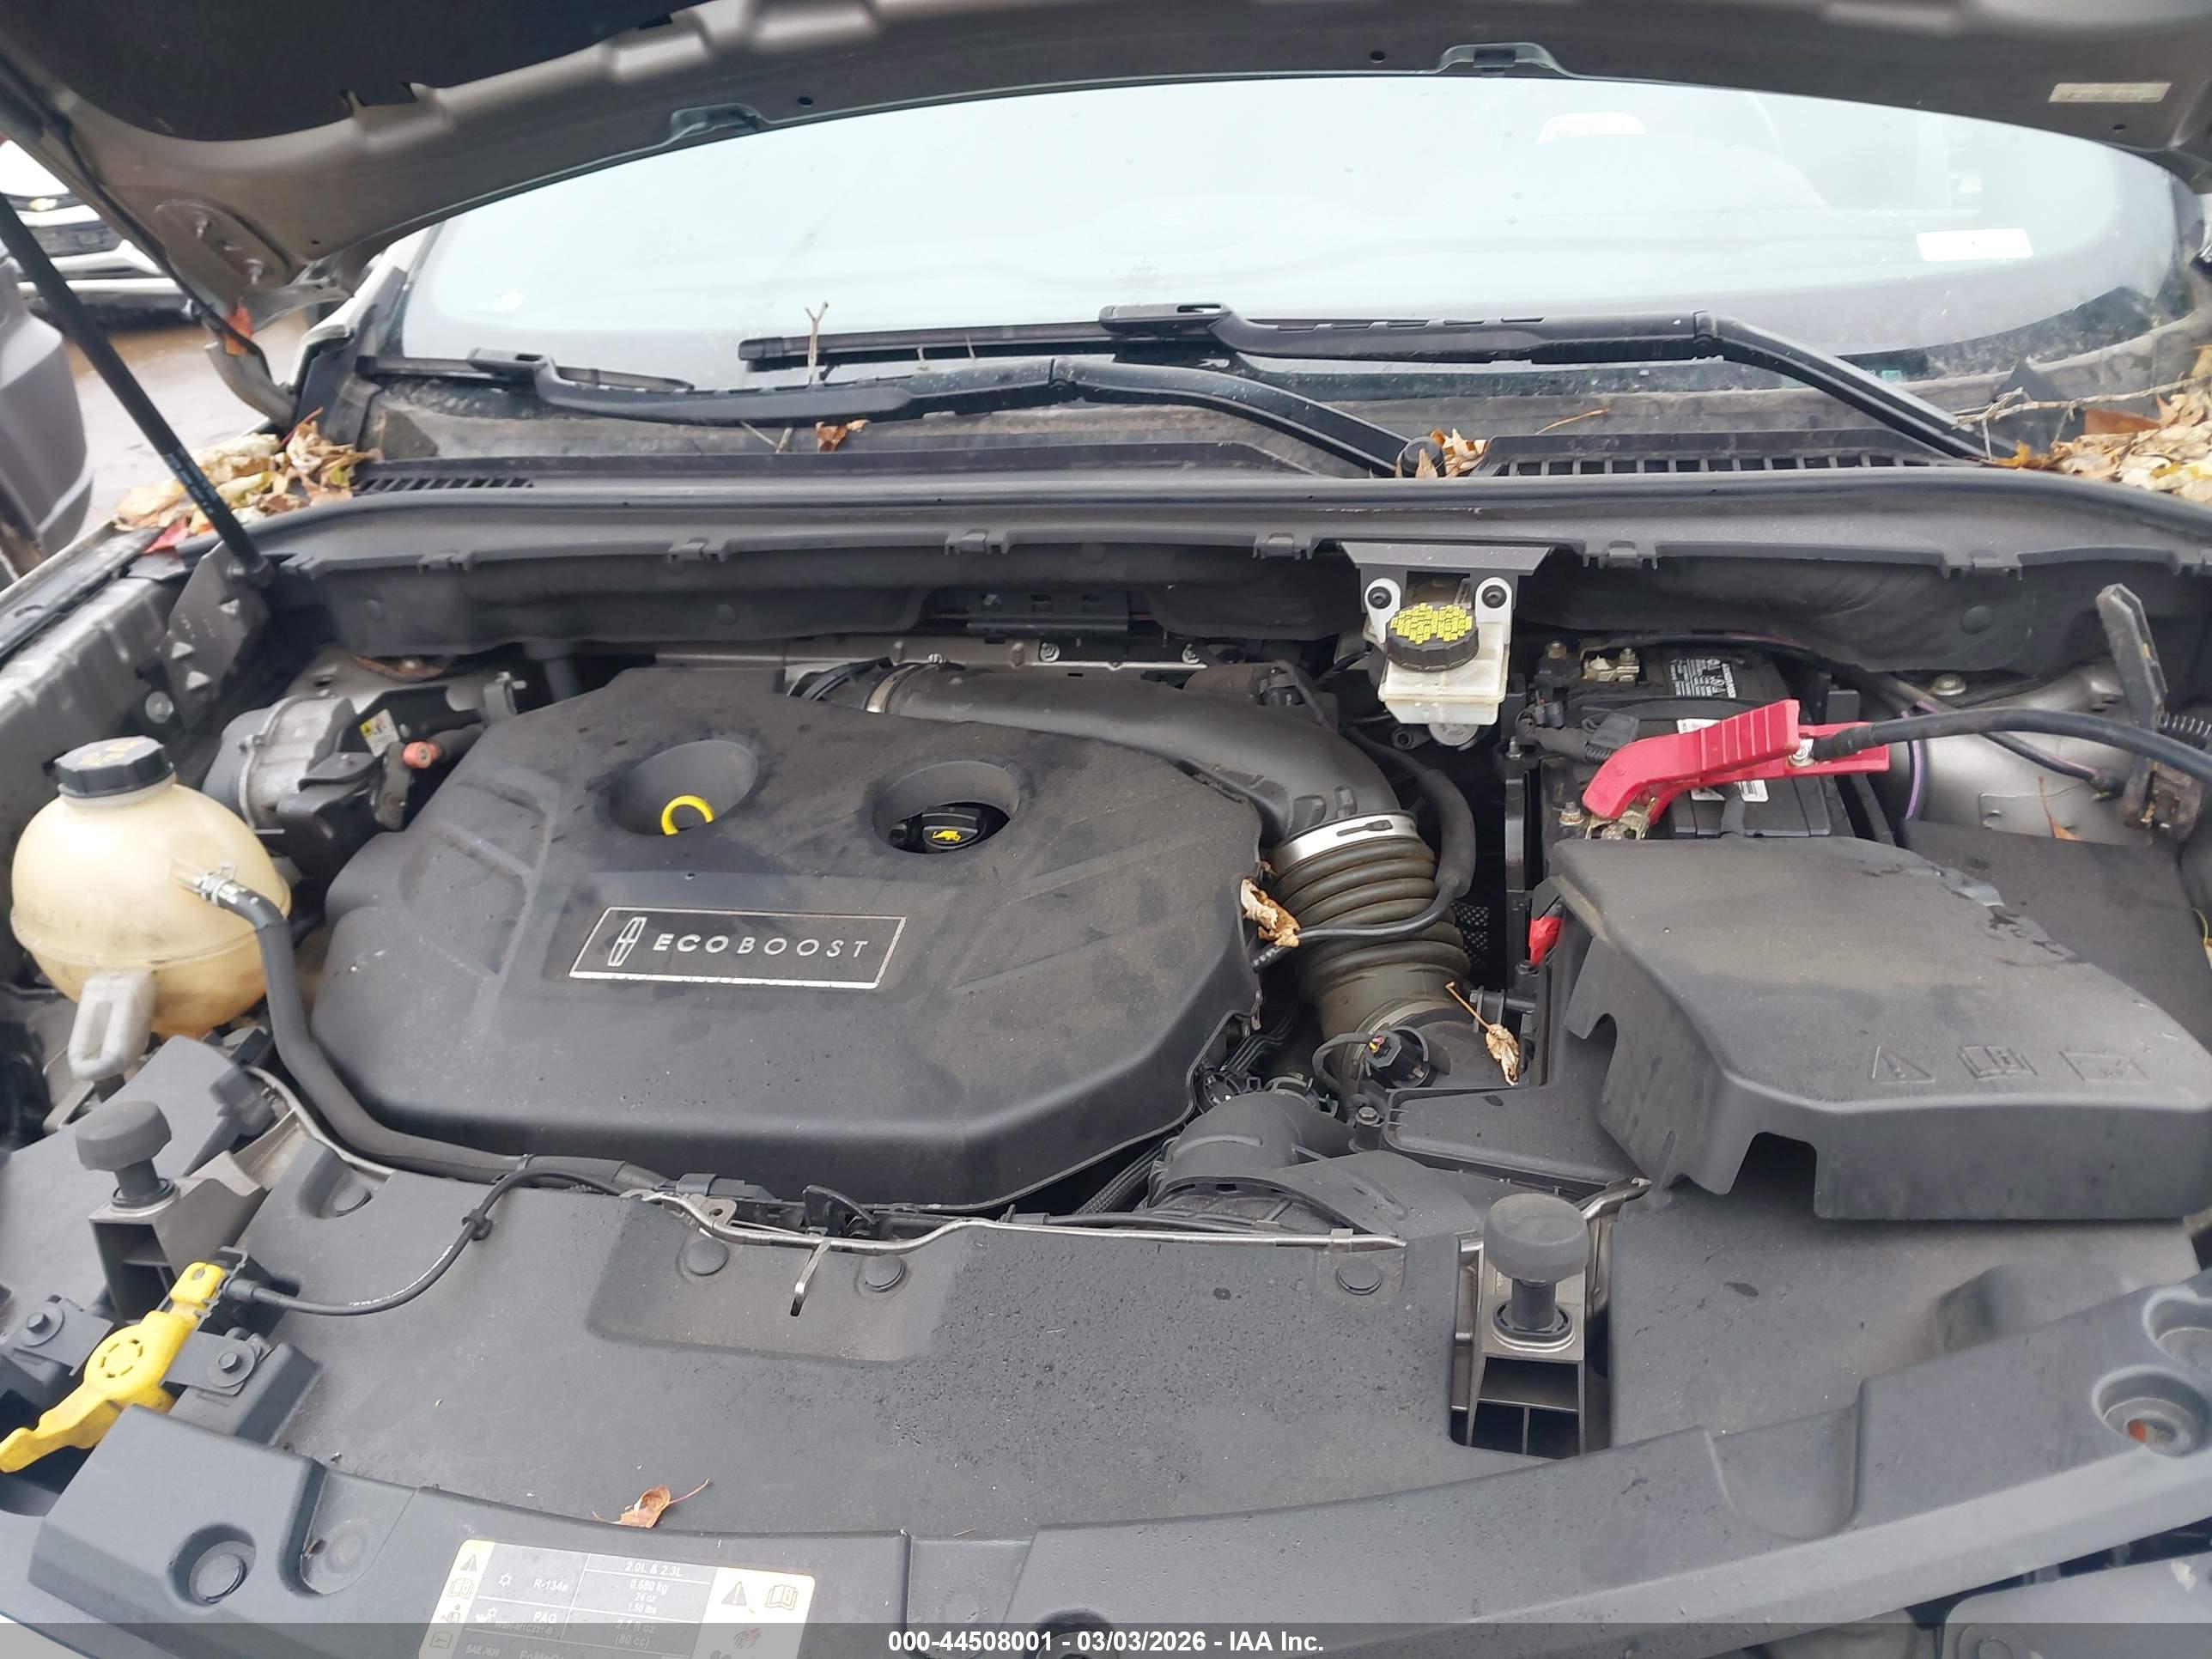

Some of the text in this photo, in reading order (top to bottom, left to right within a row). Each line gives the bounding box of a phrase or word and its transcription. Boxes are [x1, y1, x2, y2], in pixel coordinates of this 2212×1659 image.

[653, 933, 869, 957] ECOBOOST
[625, 1561, 646, 1574] 2.0L
[659, 1565, 683, 1577] 2.3L
[656, 1582, 668, 1595] kg
